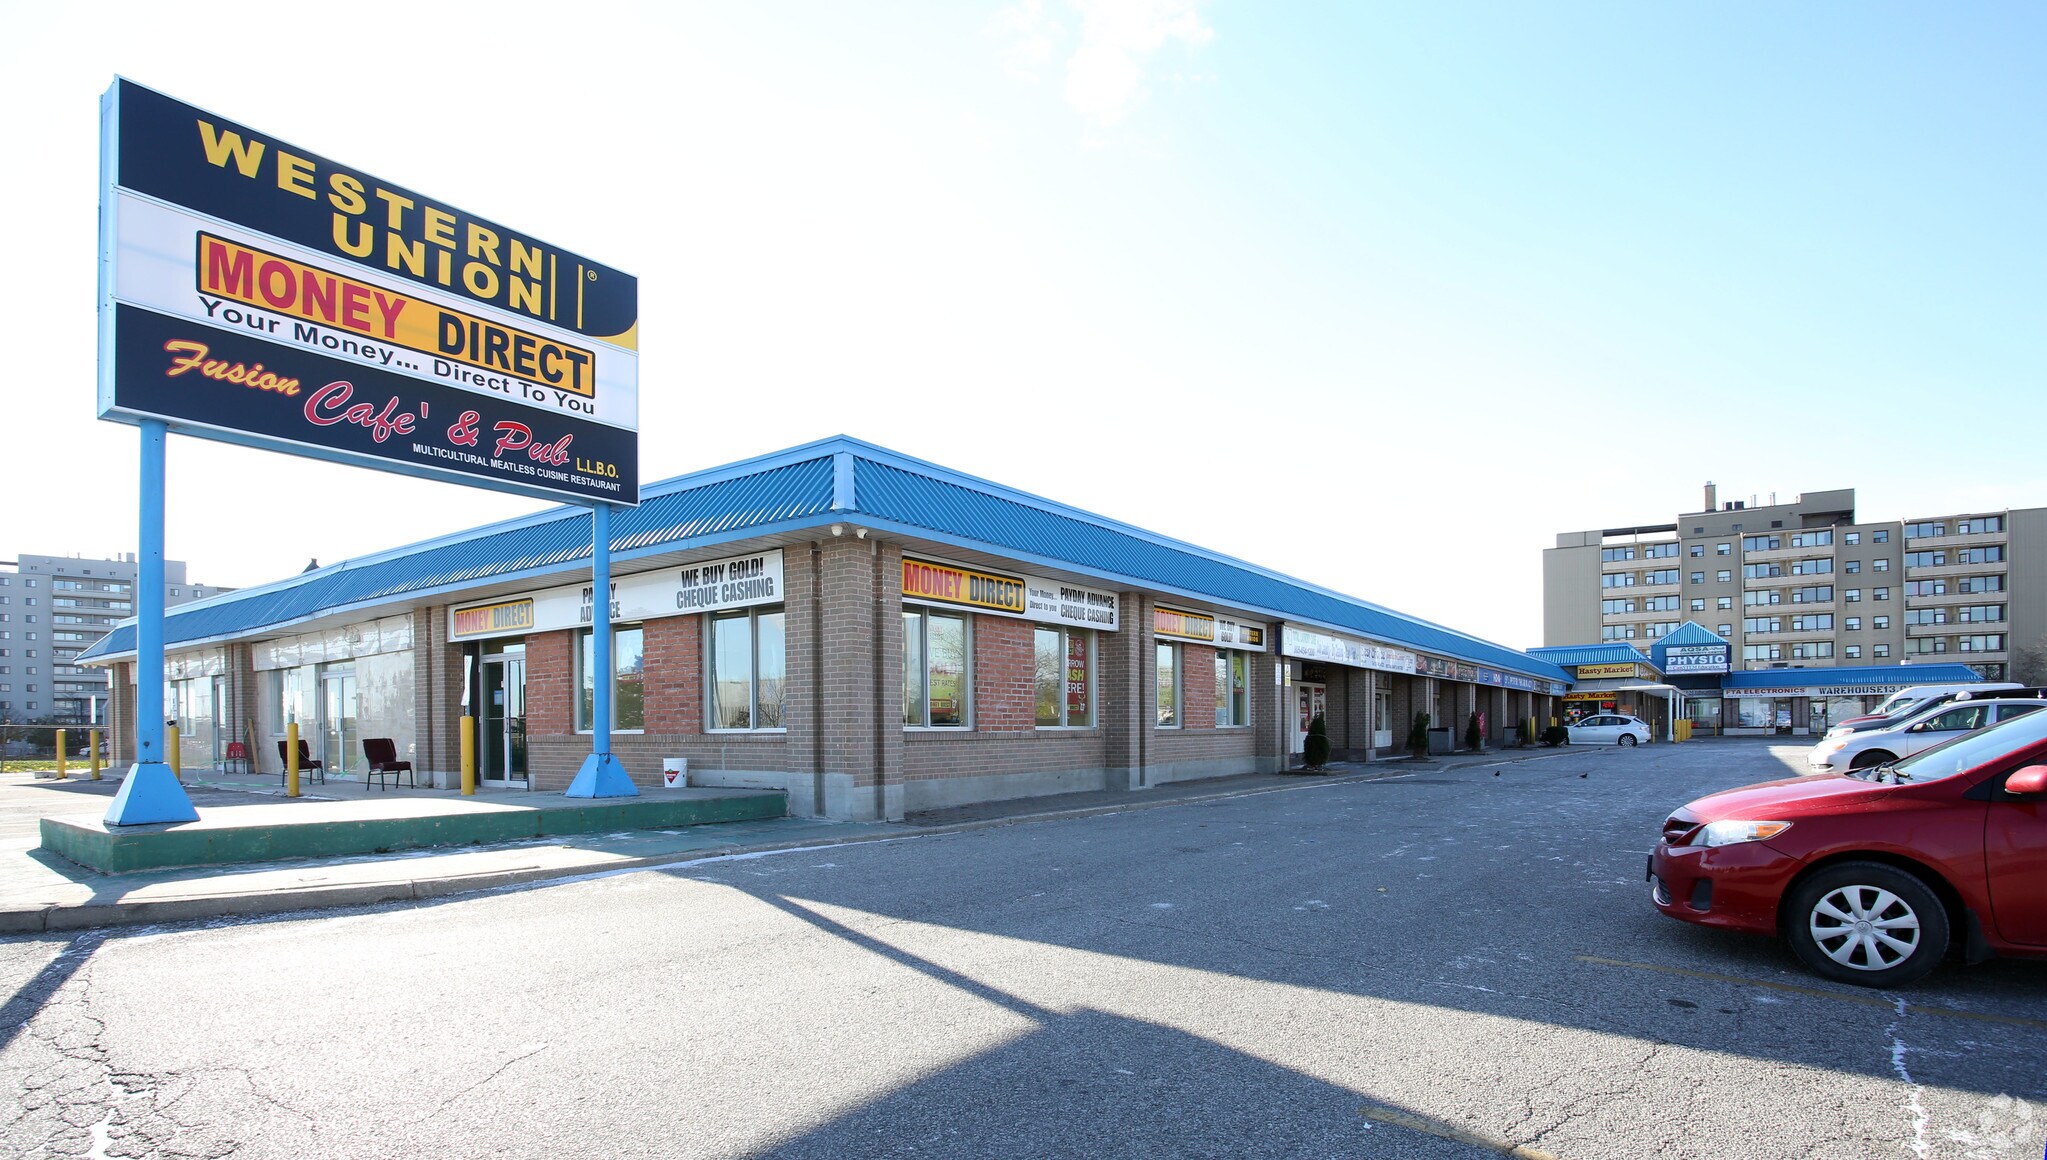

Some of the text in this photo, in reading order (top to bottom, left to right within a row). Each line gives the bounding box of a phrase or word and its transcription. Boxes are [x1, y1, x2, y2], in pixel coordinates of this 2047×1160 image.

[197, 118, 543, 281] WESTERN
[332, 212, 542, 316] UNION
[207, 240, 589, 391] MONEY DIRECT
[198, 295, 595, 416] Your Money... Direct To You
[163, 338, 301, 398] Fusion
[447, 409, 480, 447] &
[493, 419, 573, 467] Pub
[412, 442, 621, 493] MULTICULTURAL MEATLESS CUISINE RESTAURANT
[576, 456, 620, 479] L.L.B.O.
[681, 557, 764, 588] WE BUY GOLD!
[582, 583, 617, 604] PAY
[676, 577, 774, 610] CHEQUE CASHING
[903, 562, 1022, 609] MONEY DIRECT
[1028, 587, 1039, 597] Your
[1030, 600, 1043, 610] Direct
[1043, 603, 1048, 611] to
[1060, 587, 1114, 609] PAYDAY ADVANCE
[456, 602, 532, 634] MONEY DIRECT
[580, 601, 621, 623] ADCE
[1060, 604, 1114, 625] CHEQUE CASHING
[1184, 615, 1213, 638] DIRECT
[1578, 667, 1602, 675] Hasty
[1603, 666, 1633, 674] Market
[1667, 655, 1725, 665] PHYSIO
[1067, 669, 1084, 681] ASH
[1067, 682, 1085, 694] ERE!
[1563, 692, 1585, 700] Hasty
[1744, 687, 1806, 695] ELECTRONICS
